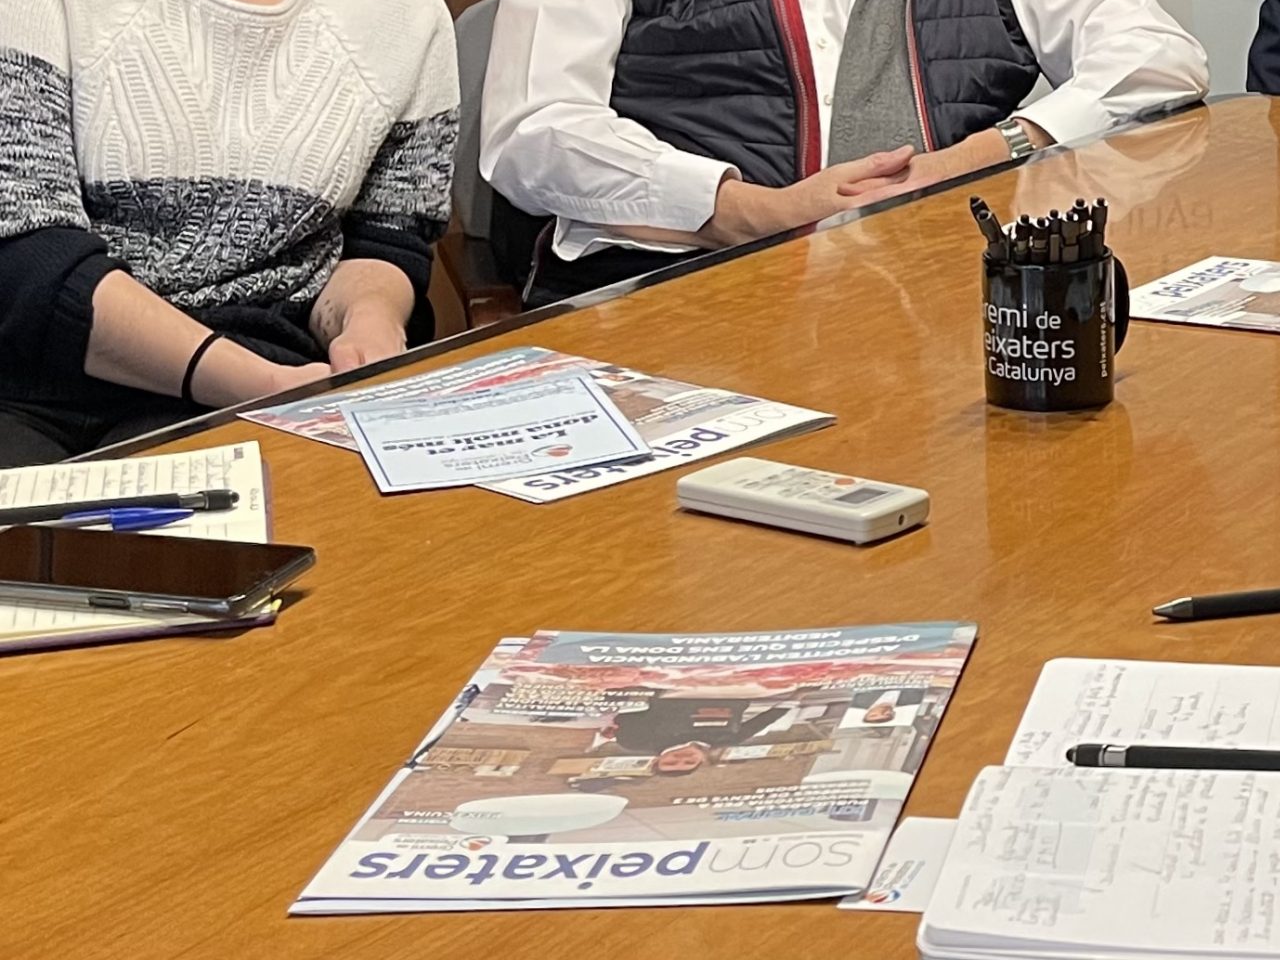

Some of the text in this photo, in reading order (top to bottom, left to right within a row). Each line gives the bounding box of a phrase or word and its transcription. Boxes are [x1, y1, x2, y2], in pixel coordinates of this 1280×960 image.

[984, 302, 1061, 329] remi de
[985, 328, 1075, 359] eixaters
[988, 356, 1076, 386] Catalunya
[382, 414, 598, 451] dona molt més
[427, 430, 567, 455] La mar et
[579, 645, 609, 654] LA
[614, 645, 685, 655] DONA
[688, 645, 733, 654] ENS
[738, 643, 788, 652] QUE
[766, 644, 901, 660] APROFITEM
